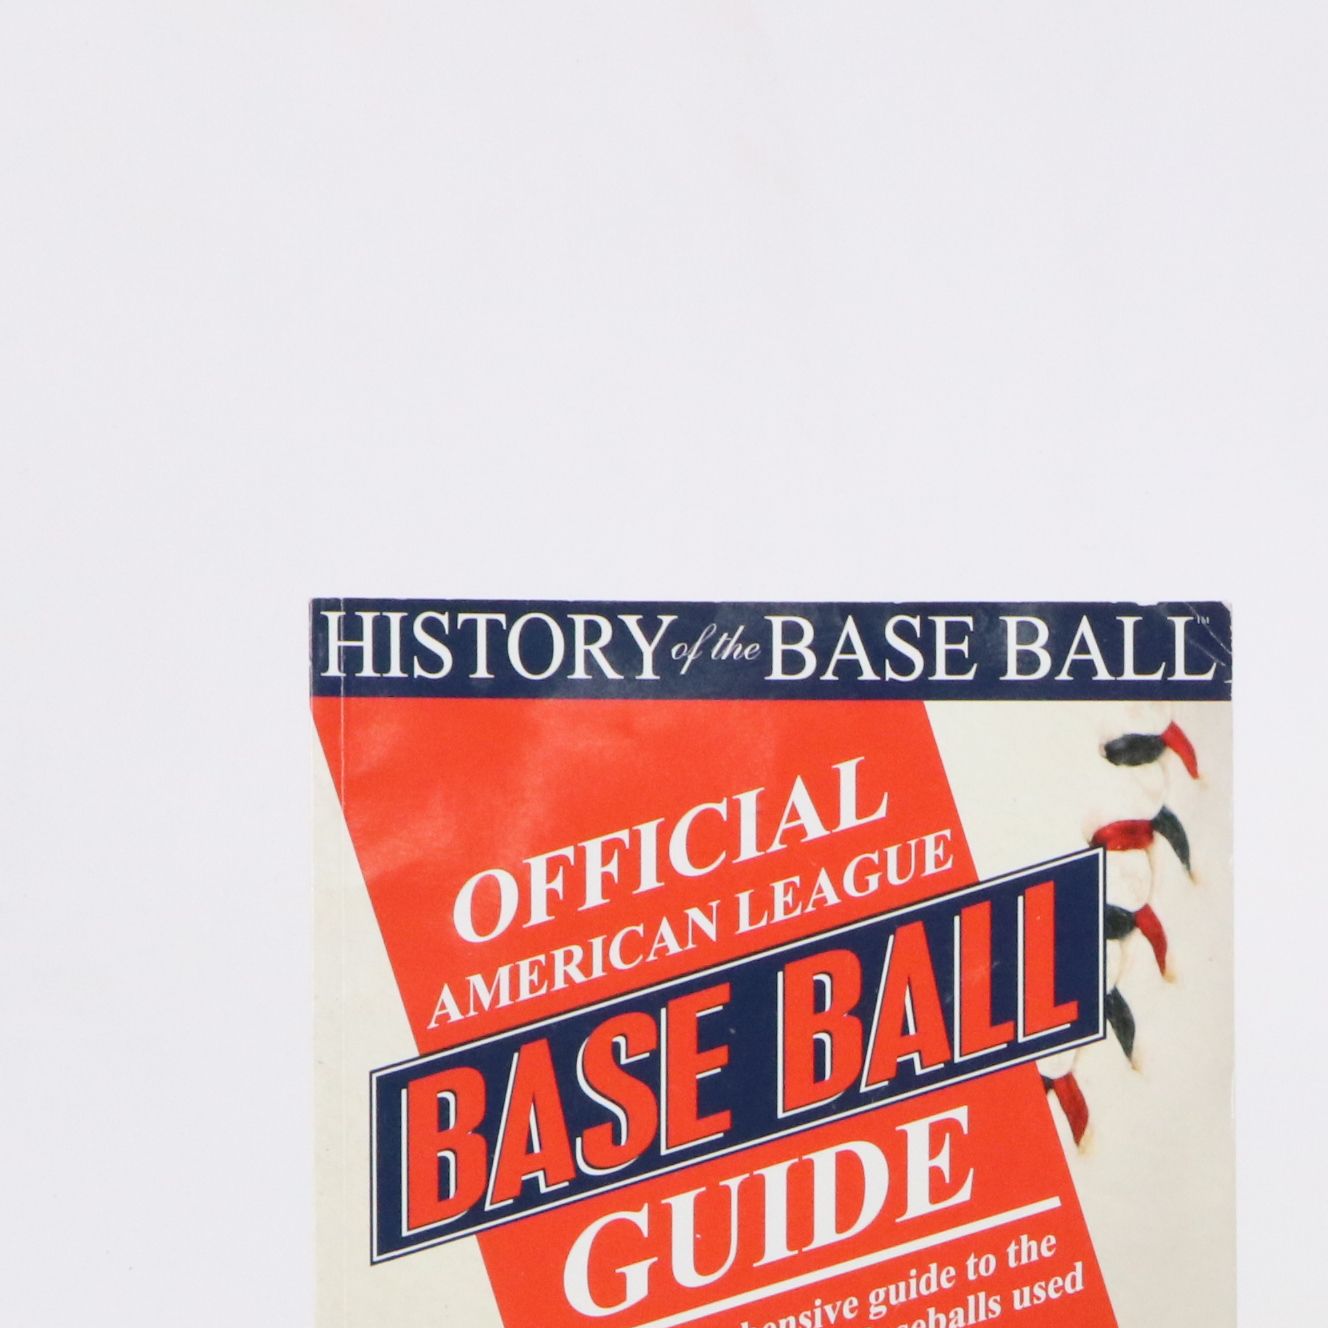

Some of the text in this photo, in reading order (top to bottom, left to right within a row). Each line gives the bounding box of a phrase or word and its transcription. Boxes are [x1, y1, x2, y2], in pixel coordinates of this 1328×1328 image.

[320, 611, 1217, 682] HISTORY of the BASE BALL
[426, 829, 954, 1030] AMERICAN LEAGUE
[453, 756, 889, 944] OFFICIAL
[400, 879, 1081, 1237] BASE BALL
[562, 1105, 975, 1317] GUIDE
[868, 1257, 957, 1323] guide
[966, 1250, 997, 1283] to
[1006, 1230, 1057, 1268] the
[1012, 1263, 1085, 1310] used
